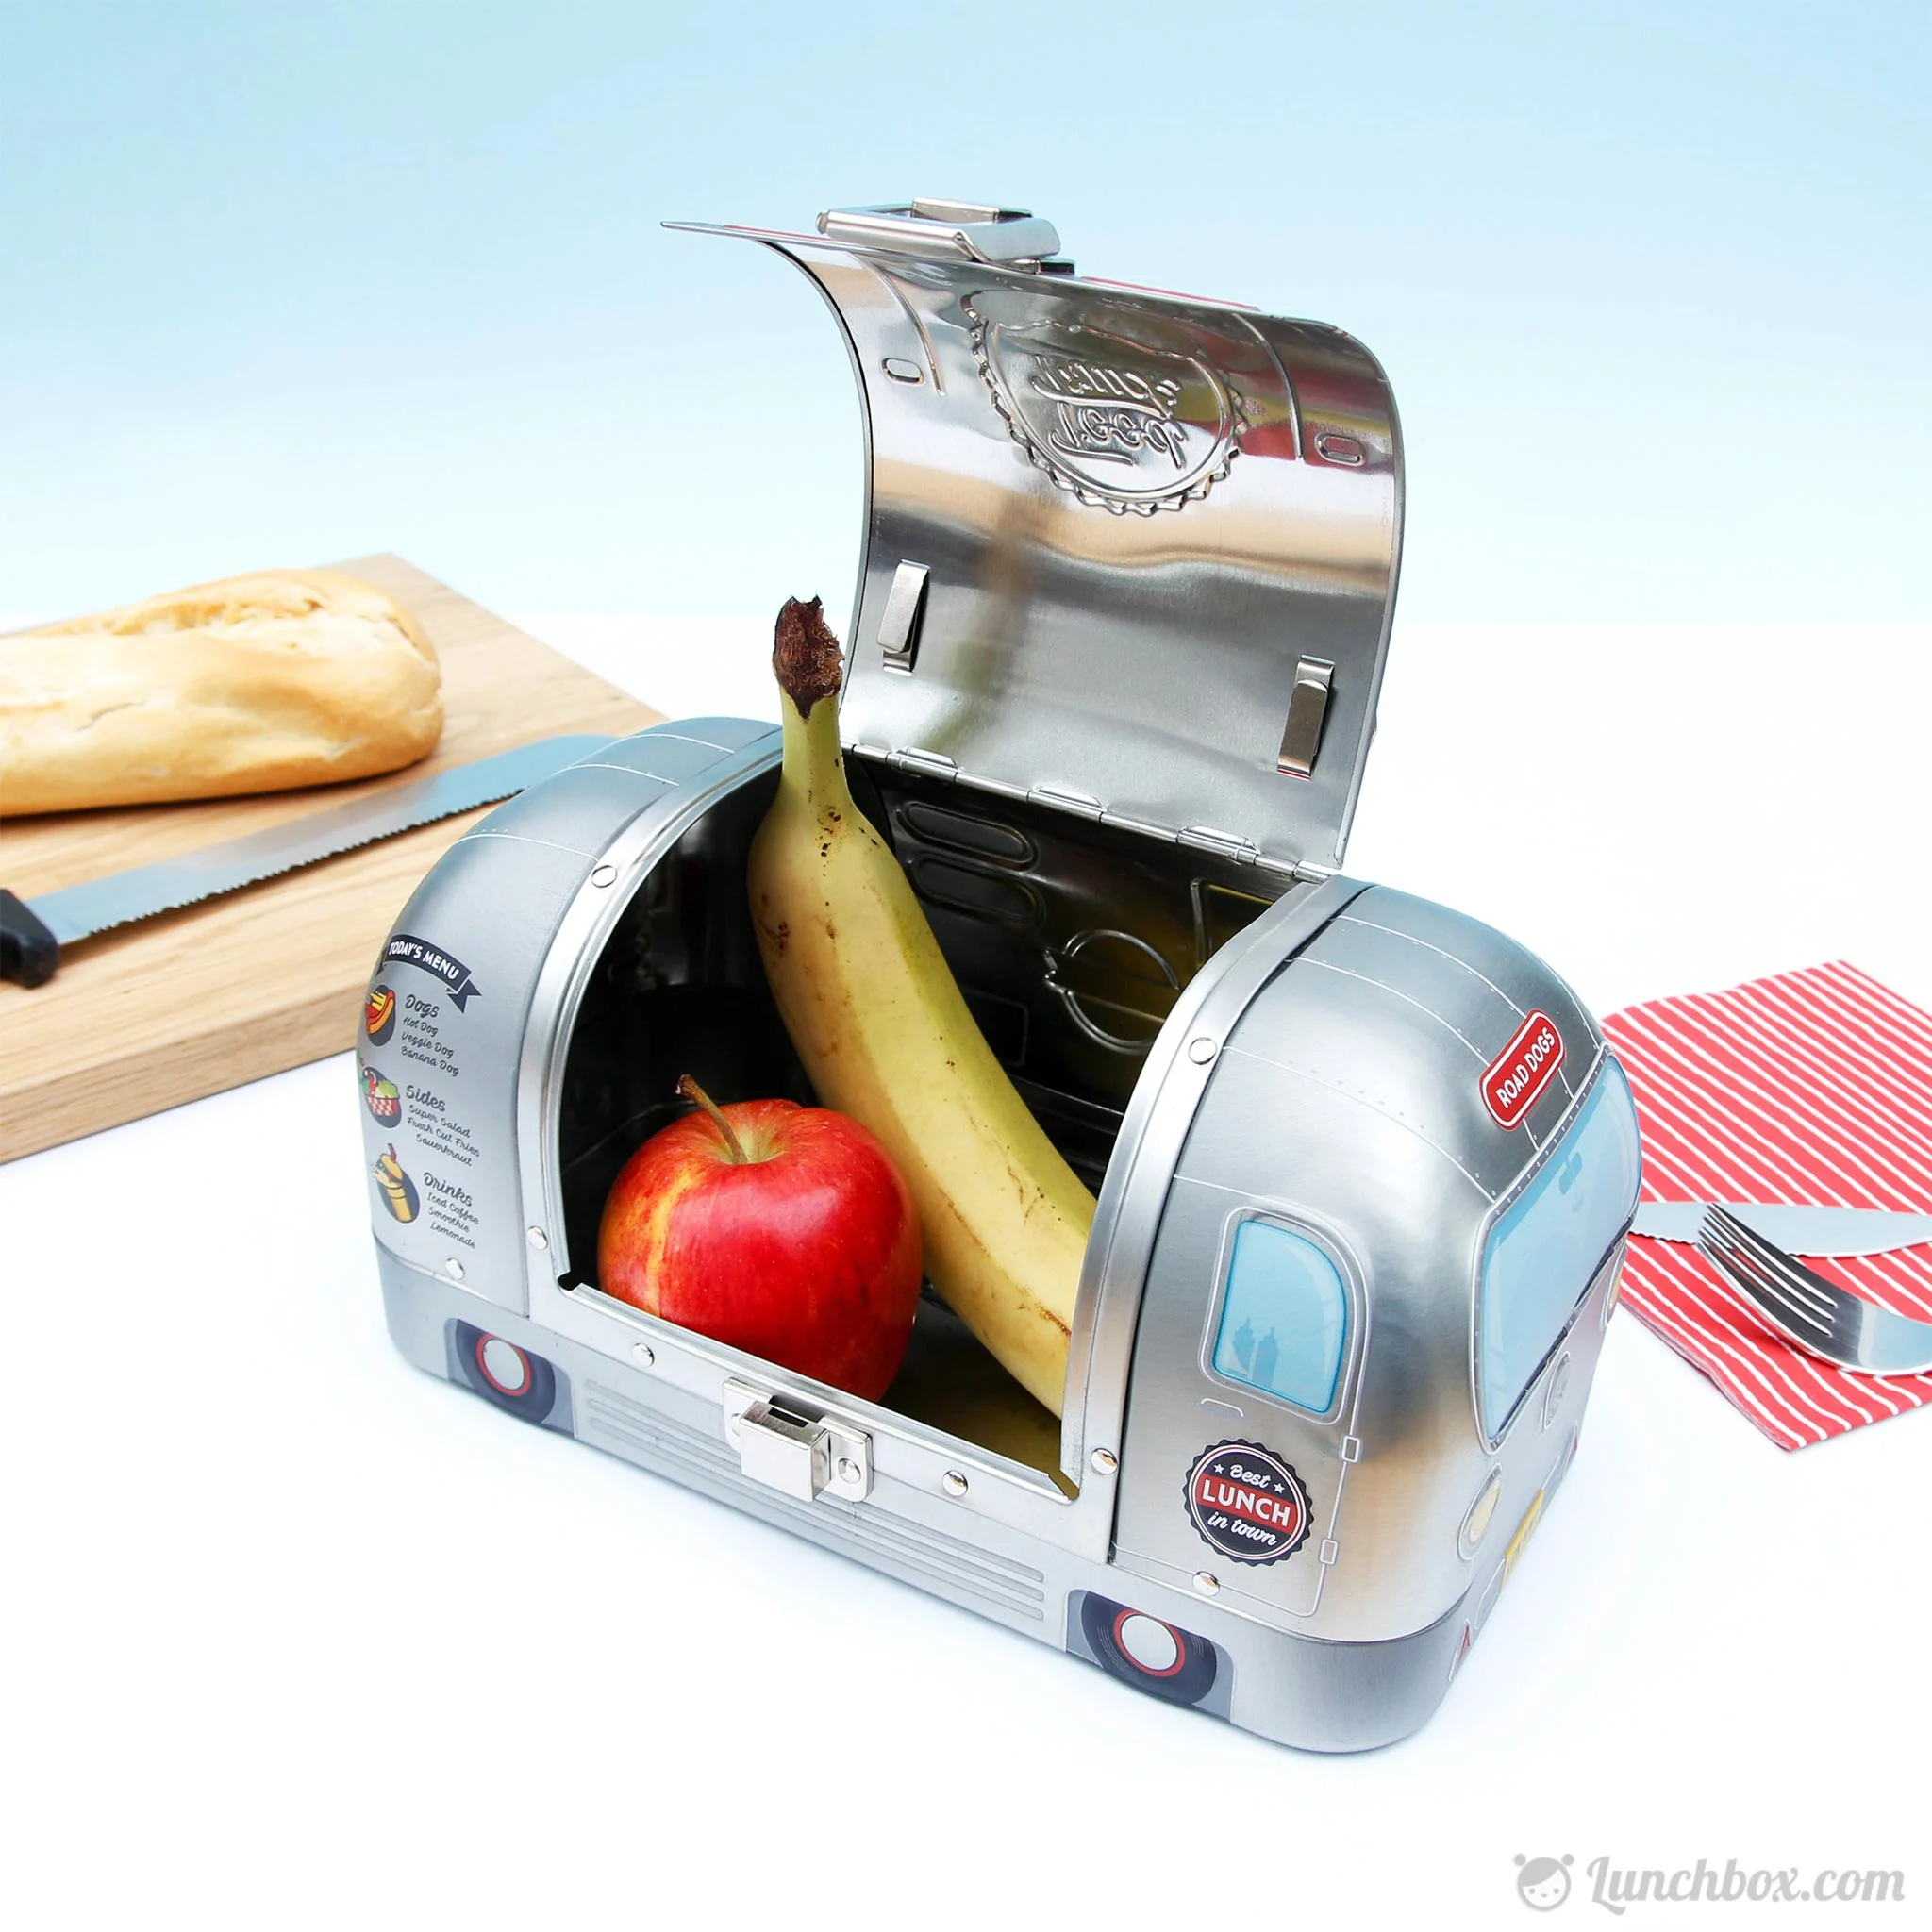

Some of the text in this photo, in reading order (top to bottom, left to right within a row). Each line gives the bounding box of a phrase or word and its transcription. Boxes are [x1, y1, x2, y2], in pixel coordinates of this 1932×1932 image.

[388, 941, 460, 980] TODAY'S MENU
[405, 993, 440, 1019] Dogs
[402, 1015, 439, 1038] Hot Dog
[401, 1031, 455, 1060] Veggie Dog
[401, 1046, 460, 1077] Banana Dog
[1495, 1026, 1556, 1108] ROAD DOGS
[406, 1085, 446, 1113] Sides
[407, 1116, 480, 1158] Fresh Cut Fries
[408, 1104, 471, 1139] Super Salad
[415, 1133, 473, 1167] Sauerkraut
[423, 1172, 474, 1208] Drinks
[426, 1191, 480, 1225] Iced Coffee
[427, 1207, 471, 1234] Smoothie
[430, 1221, 476, 1250] Lemonade
[1229, 1464, 1272, 1489] Best
[1202, 1479, 1291, 1527] LUNCH
[1208, 1511, 1277, 1546] in town
